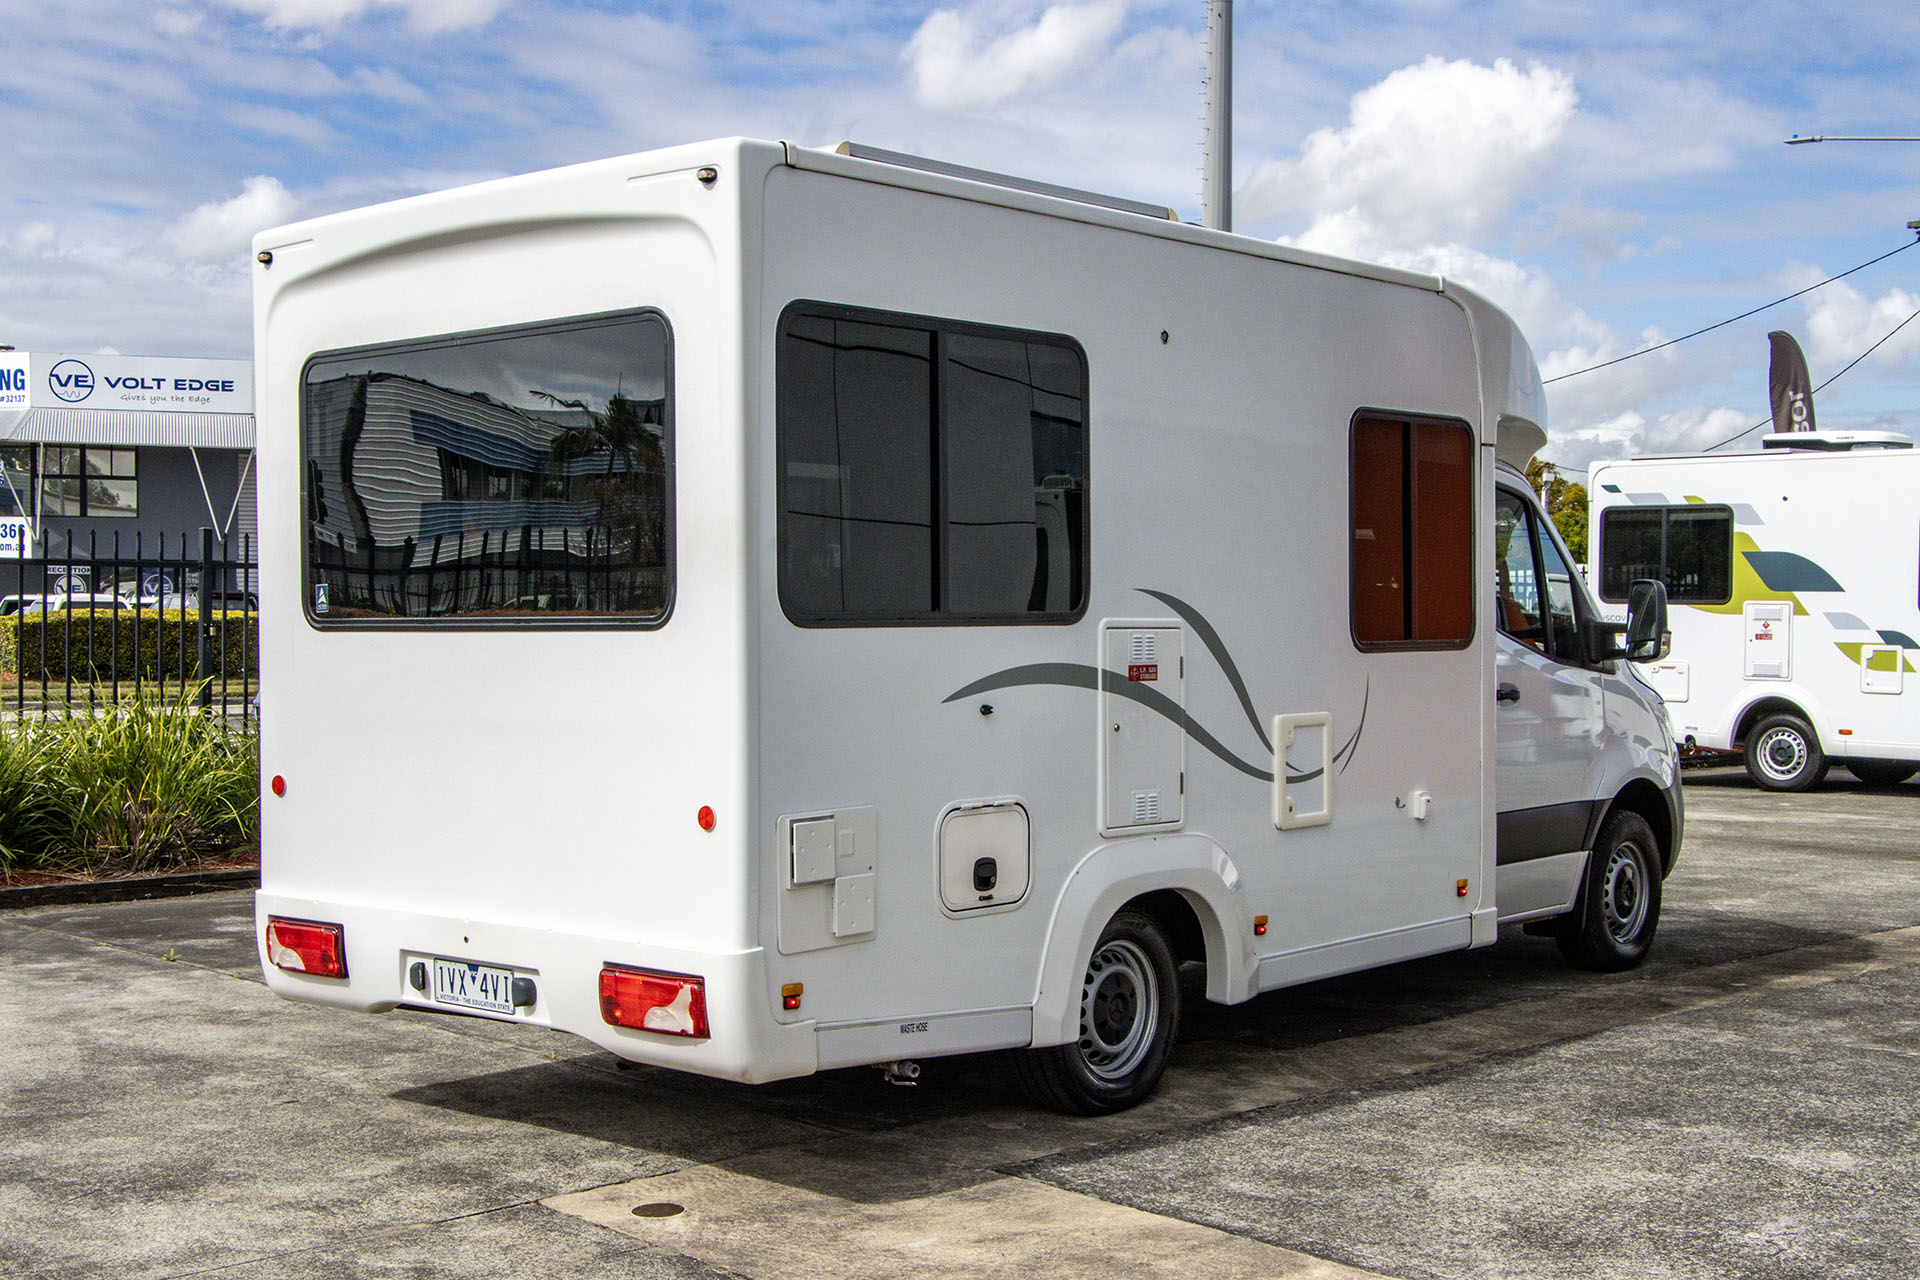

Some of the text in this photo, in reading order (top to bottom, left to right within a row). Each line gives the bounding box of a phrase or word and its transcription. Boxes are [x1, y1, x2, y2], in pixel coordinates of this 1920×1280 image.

[0, 368, 25, 391] NG
[51, 374, 93, 388] VE
[103, 376, 235, 392] VOLT EDGE
[120, 393, 211, 405] Gives you the Edge
[440, 993, 459, 1002] VICTORIA
[463, 997, 471, 1005] THE
[472, 999, 497, 1009] EDUCATION
[497, 1003, 510, 1012] STATE
[916, 1022, 928, 1033] HOSE
